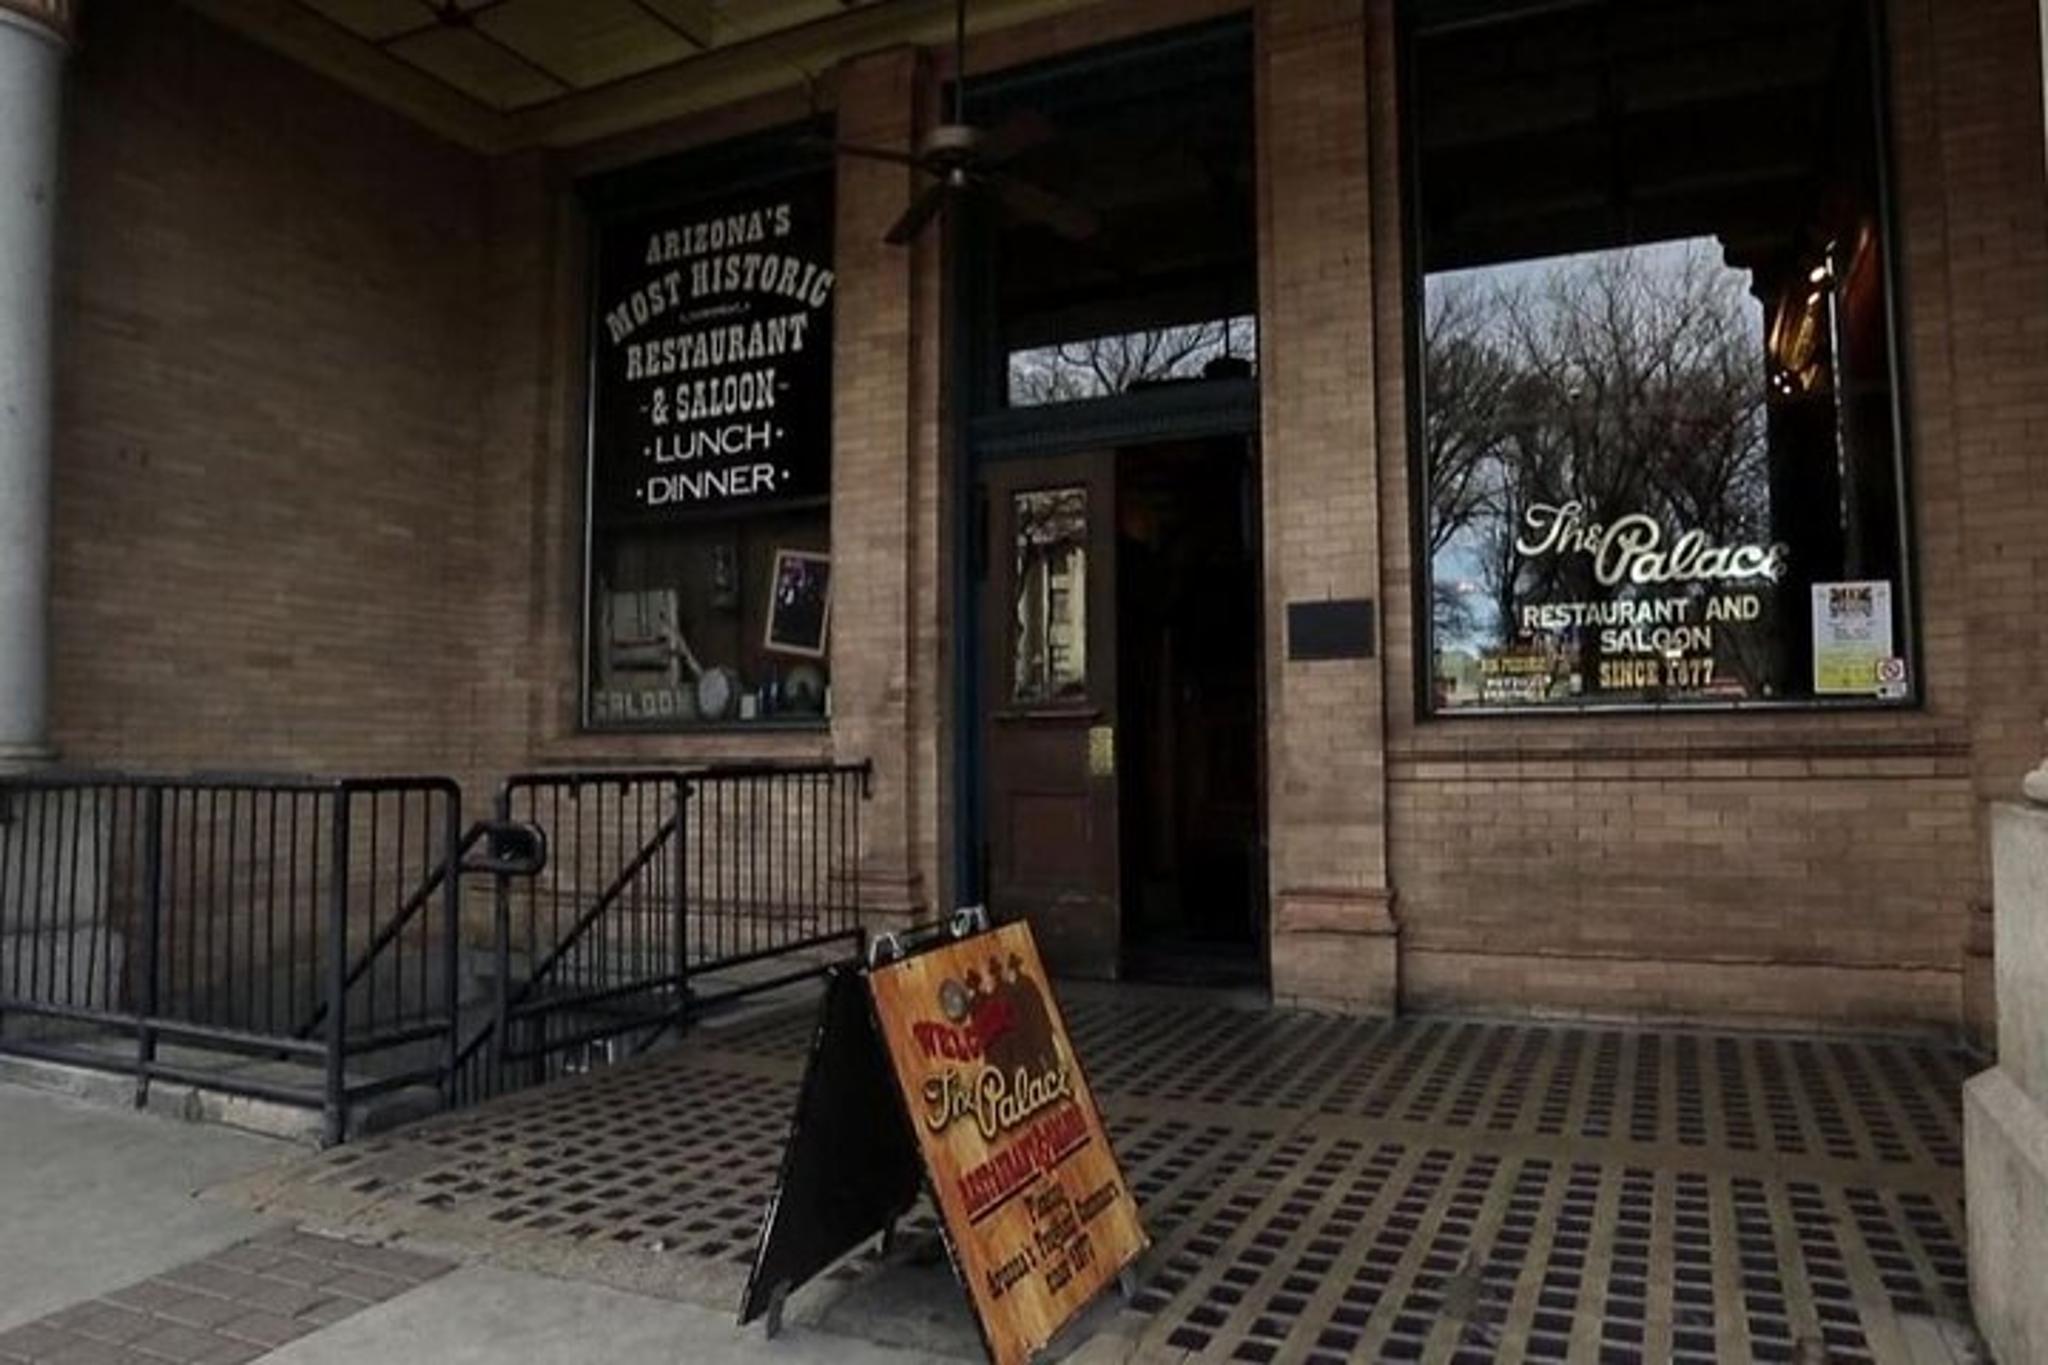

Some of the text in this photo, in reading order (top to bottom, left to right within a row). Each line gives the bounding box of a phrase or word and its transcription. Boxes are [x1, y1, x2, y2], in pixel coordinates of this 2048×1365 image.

[646, 204, 791, 265] ARIZONA'S
[606, 253, 835, 345] MOST HISTORIC
[626, 312, 808, 381] RESTAURANT
[652, 368, 775, 425] & SALOON
[656, 421, 771, 463] LUNCH
[648, 463, 775, 505] DINNER
[1516, 500, 1789, 584] The Palace
[1523, 595, 1761, 629] RESTAURANT AND
[1600, 626, 1712, 653] SALOON
[1601, 659, 1659, 688] SINCE
